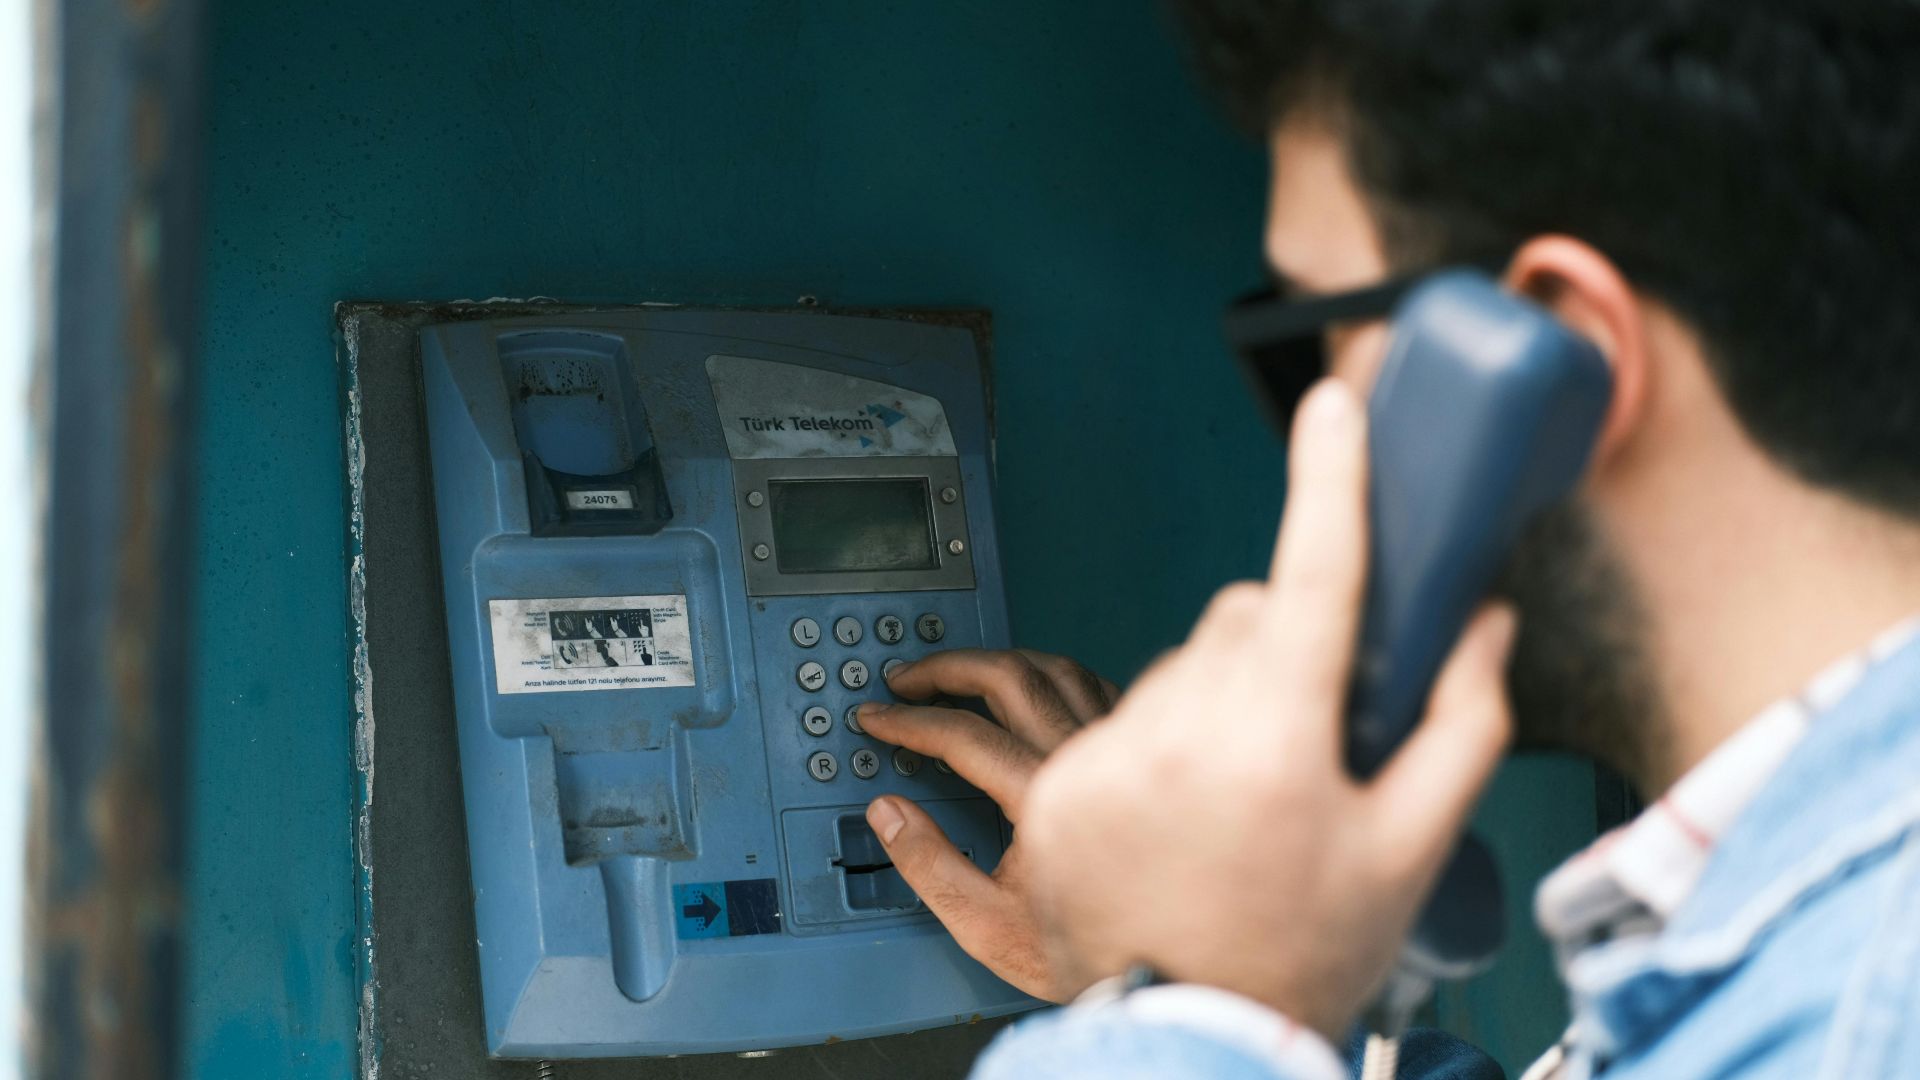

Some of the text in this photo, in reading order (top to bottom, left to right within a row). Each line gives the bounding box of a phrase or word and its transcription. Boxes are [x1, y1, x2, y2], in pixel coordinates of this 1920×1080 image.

[739, 416, 874, 432] Türk Telekom
[583, 495, 618, 504] 24076
[847, 629, 855, 641] 1
[888, 629, 898, 641] 2
[929, 627, 938, 640] 3
[613, 676, 640, 684] telefonu
[853, 673, 862, 685] 4
[818, 758, 832, 774] R
